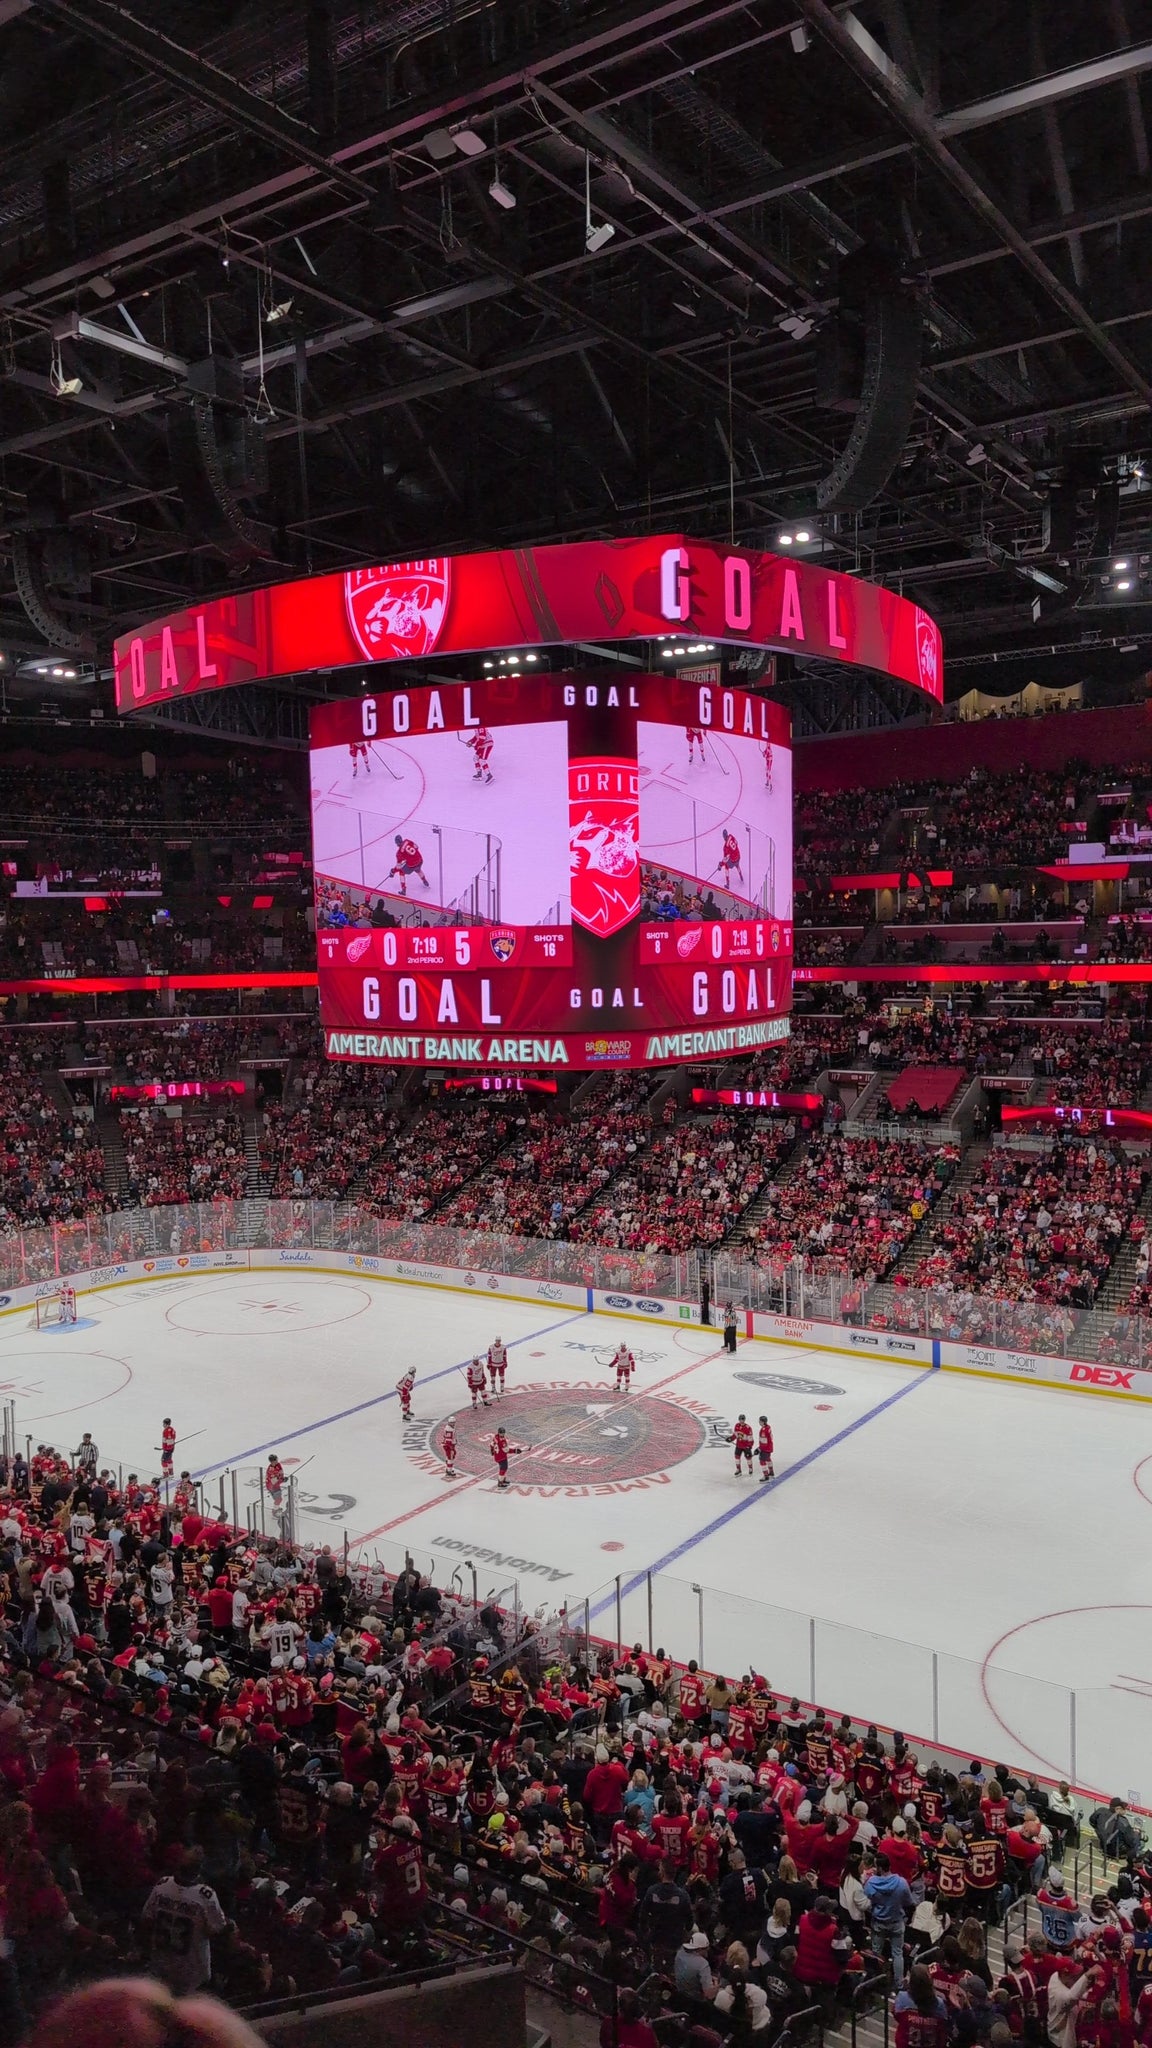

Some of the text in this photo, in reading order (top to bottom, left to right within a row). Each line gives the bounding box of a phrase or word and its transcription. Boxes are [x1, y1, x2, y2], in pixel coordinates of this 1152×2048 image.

[660, 547, 847, 649] GOAL
[114, 615, 217, 707] OAL
[564, 685, 640, 708] GOAL
[362, 687, 480, 737] GOAL
[699, 686, 769, 739] GOAL
[412, 937, 437, 954] 7:19
[533, 934, 564, 943] SHOTS
[646, 931, 669, 940] SHOTS
[711, 924, 723, 959] 0
[732, 929, 748, 947] 7:19
[755, 923, 764, 956] 5
[383, 931, 397, 966] 0
[455, 930, 471, 966] 5
[543, 943, 556, 957] 16
[655, 941, 661, 954] 8
[419, 956, 444, 964] PERIOD
[362, 976, 501, 1025] GOAL
[570, 987, 644, 1008] GOAL
[692, 967, 775, 1016] GOAL
[328, 1032, 569, 1063] AMERANT BANK ARENA
[646, 1016, 791, 1060] AMERANT BANK ARENA
[482, 1078, 523, 1091] GOAL
[733, 1090, 780, 1107] GOAL
[279, 1250, 314, 1261] Sandals
[90, 1267, 115, 1278] OMEGA
[90, 1273, 114, 1285] SPORT
[114, 1266, 128, 1277] XL
[609, 1297, 628, 1307] Ford
[640, 1302, 659, 1312] Ford
[774, 1319, 814, 1331] AMERANT
[784, 1329, 803, 1339] BANK
[1069, 1364, 1136, 1389] DEX
[655, 1390, 718, 1415] BANK
[402, 1418, 436, 1451] ARENA
[431, 1536, 575, 1582] AutoNation
[87, 1584, 97, 1601] 5
[275, 1635, 291, 1653] 19
[681, 1687, 697, 1707] 72
[728, 1718, 745, 1741] 72
[809, 1751, 828, 1770] 63
[926, 1801, 936, 1817] 9
[972, 1852, 996, 1878] 63
[405, 1861, 422, 1895] 9
[939, 1865, 965, 1891] 63
